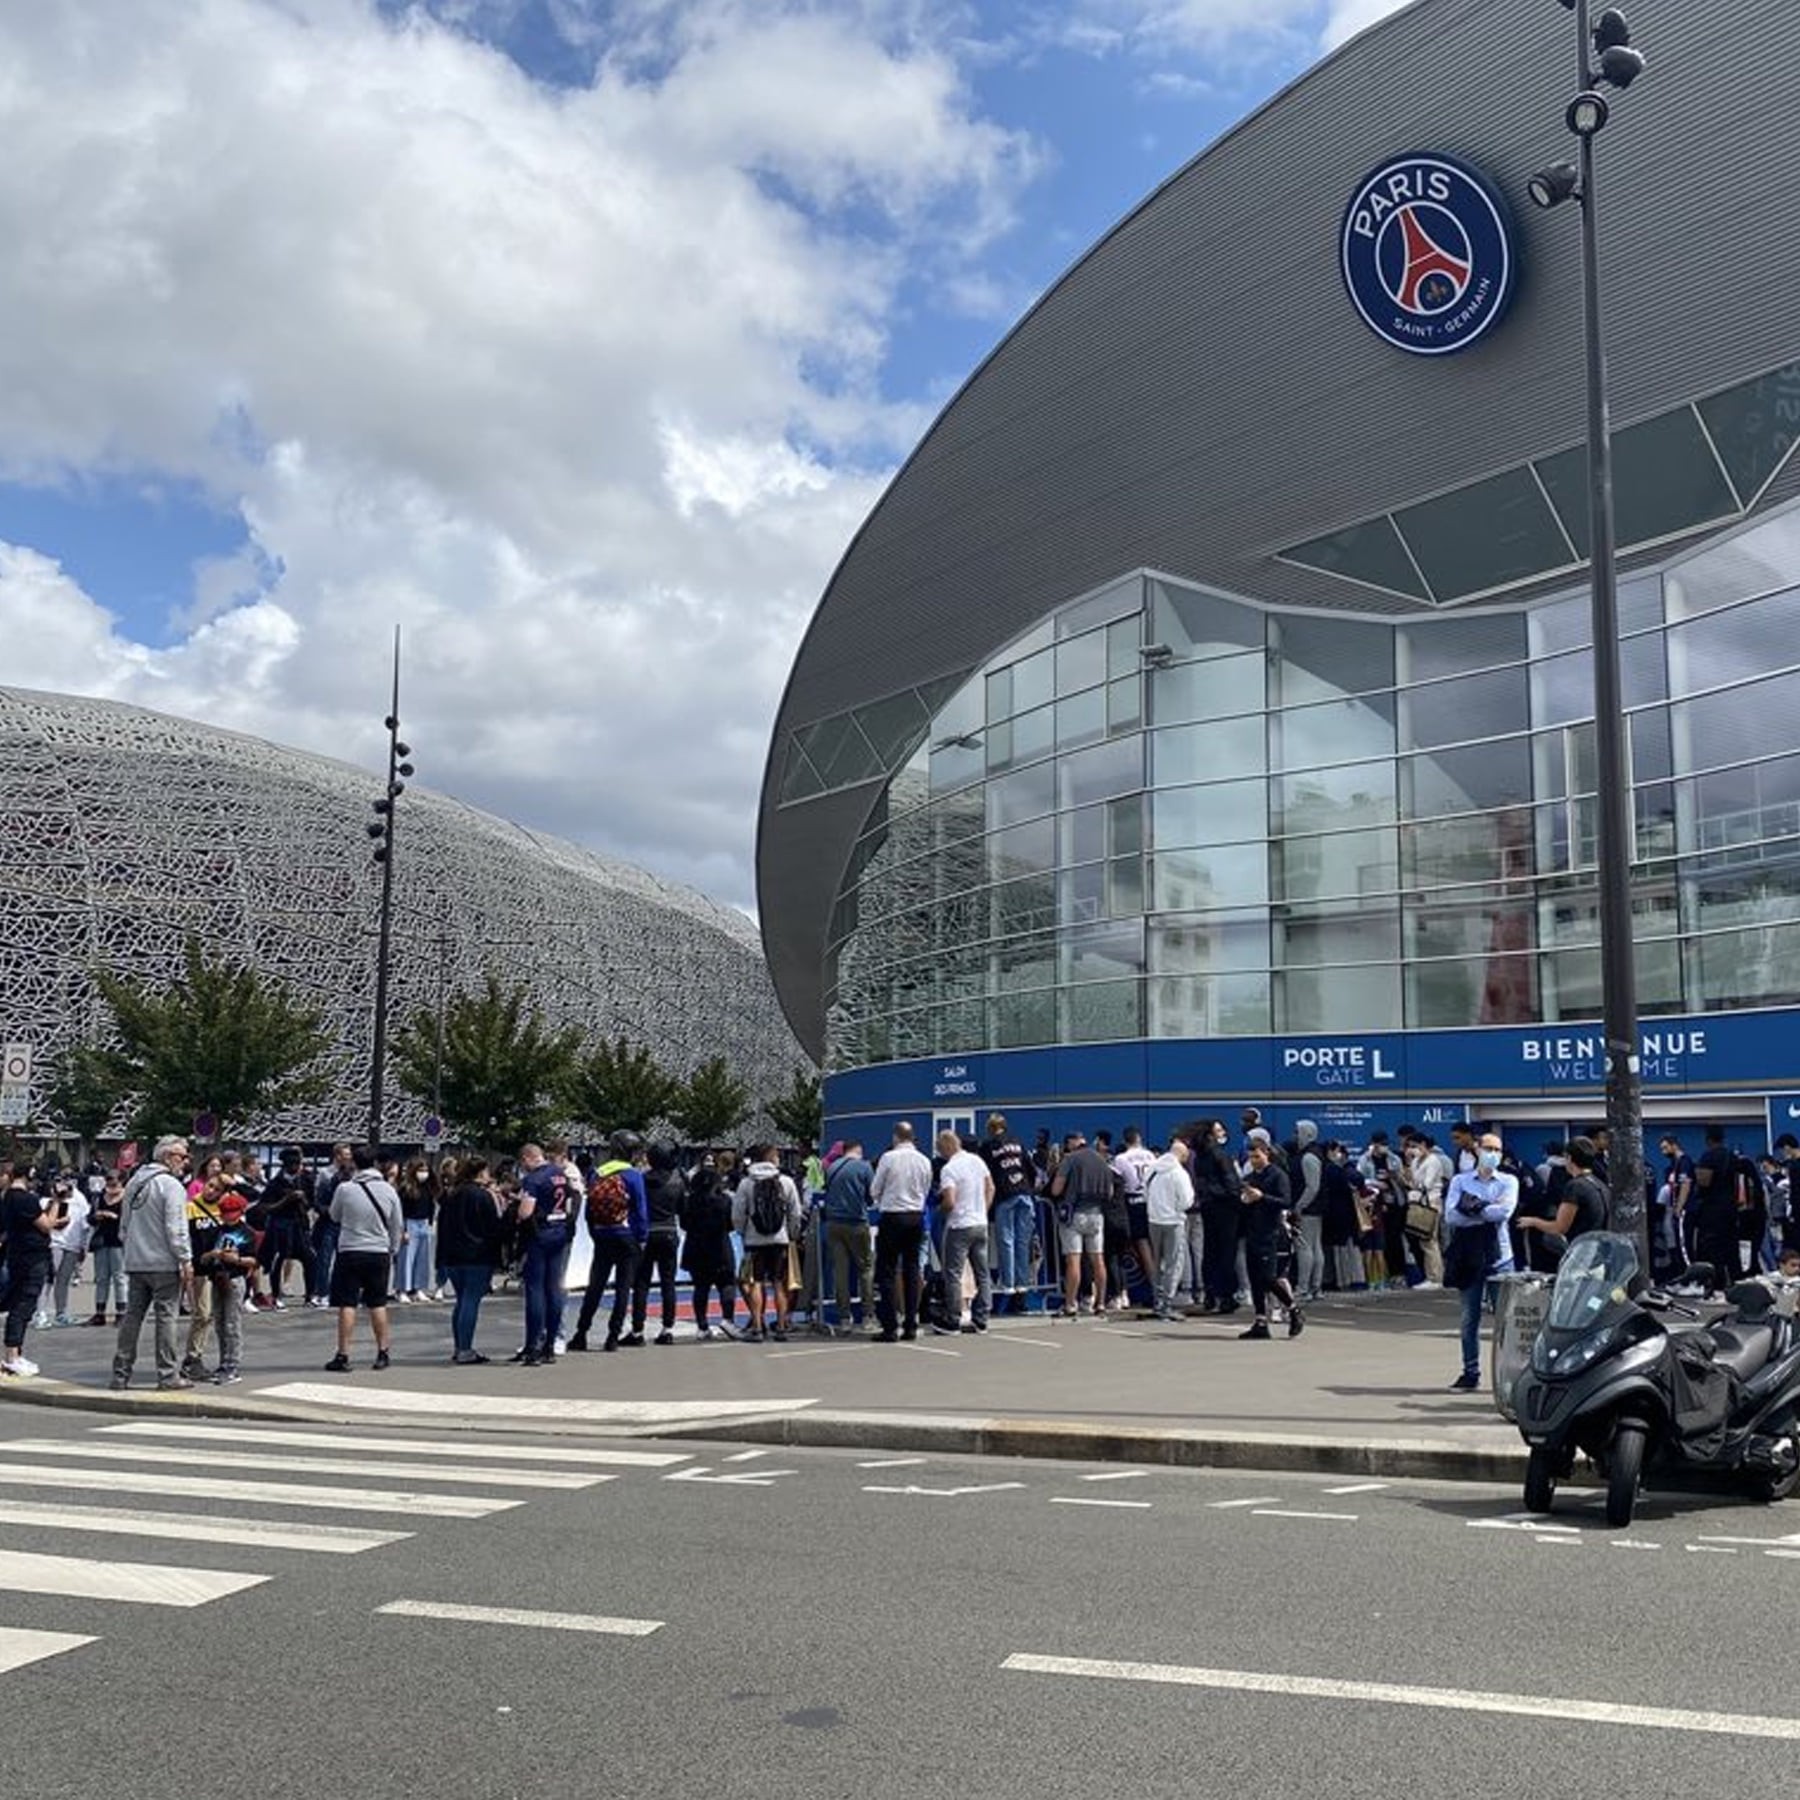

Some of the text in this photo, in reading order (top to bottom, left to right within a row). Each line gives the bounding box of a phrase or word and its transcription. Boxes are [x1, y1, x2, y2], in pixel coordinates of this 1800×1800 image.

[1354, 169, 1450, 239] PARIS
[1392, 277, 1491, 337] SAINT GERMAIN
[1522, 1031, 1707, 1060] BIENNUE
[1284, 1046, 1395, 1078] PORTE L
[1316, 1068, 1366, 1085] GATE
[1549, 1057, 1679, 1080] WELME
